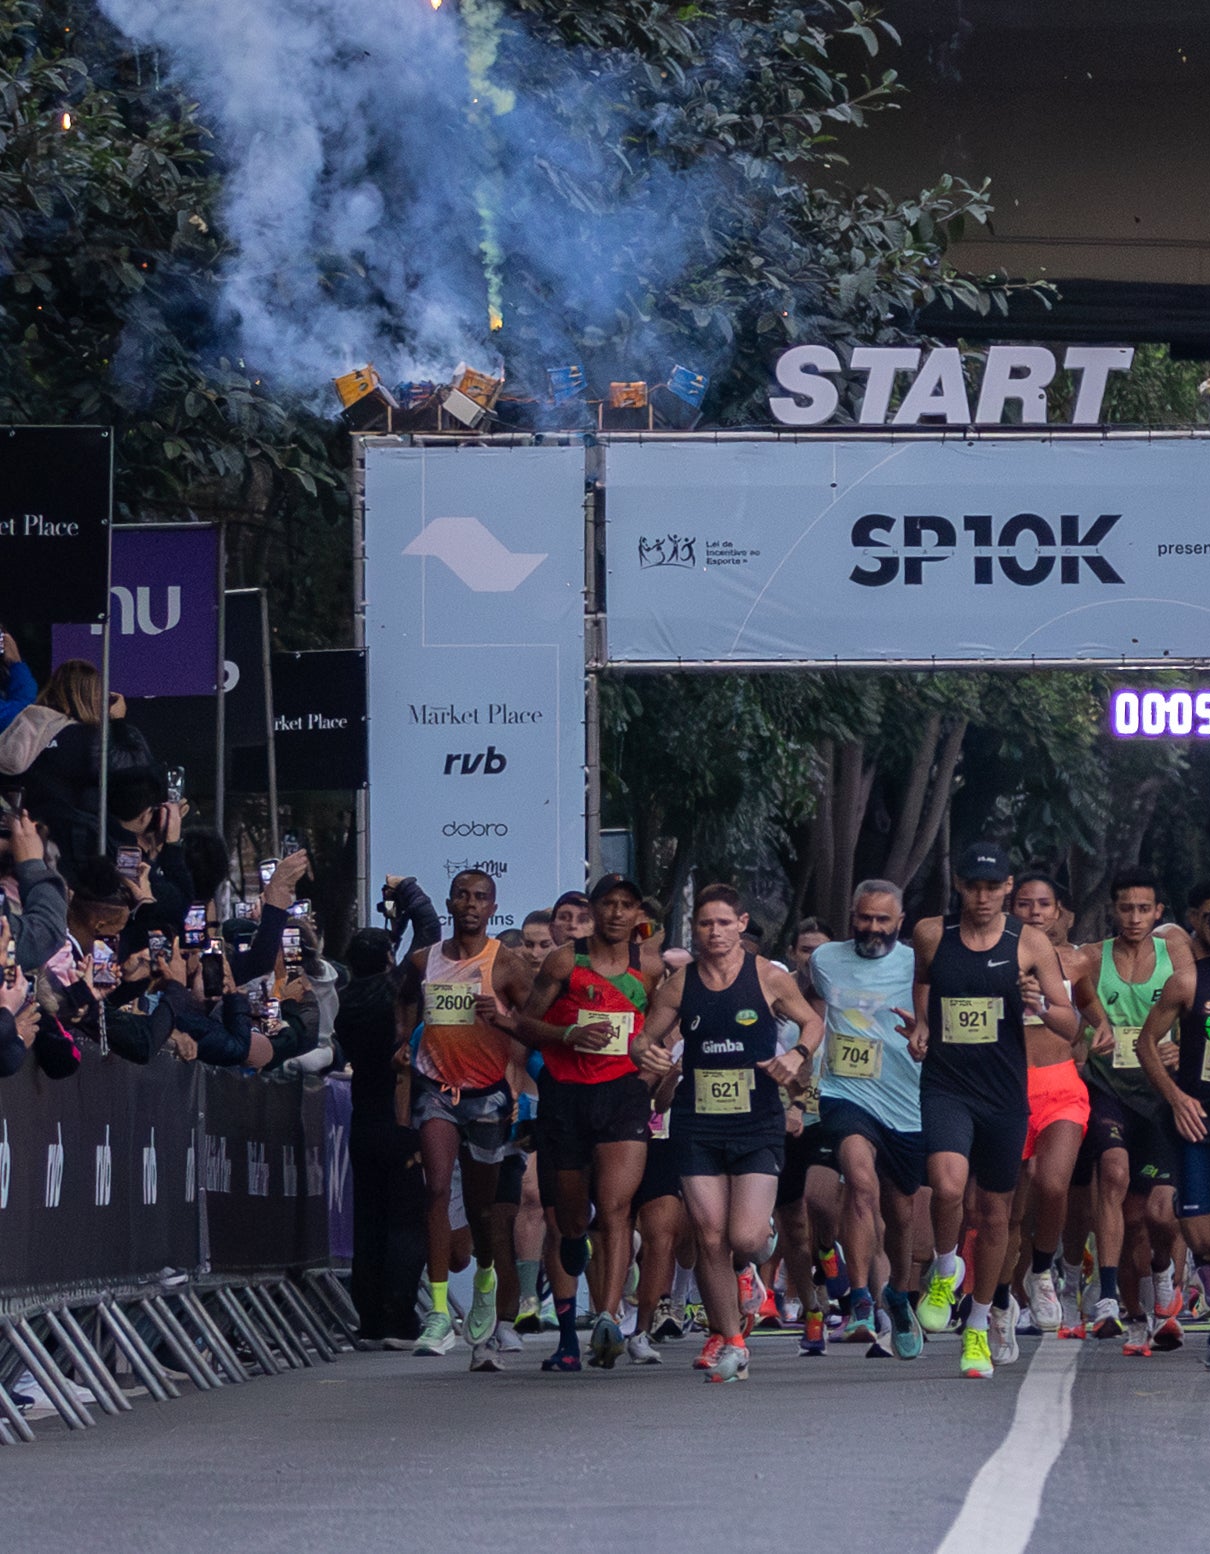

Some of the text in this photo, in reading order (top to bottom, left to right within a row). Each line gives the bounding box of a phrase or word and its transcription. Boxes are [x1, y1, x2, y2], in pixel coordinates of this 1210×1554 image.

[768, 344, 1135, 425] START
[23, 514, 79, 537] Place
[849, 513, 1126, 587] SP10K
[274, 713, 348, 731] rket Place
[489, 704, 543, 725] Place
[443, 746, 507, 775] rvb
[442, 821, 508, 837] dobro
[435, 995, 472, 1010] 2600
[959, 1010, 988, 1028] 921
[702, 1038, 745, 1054] Gimba
[842, 1045, 869, 1065] 704
[711, 1081, 740, 1099] 621
